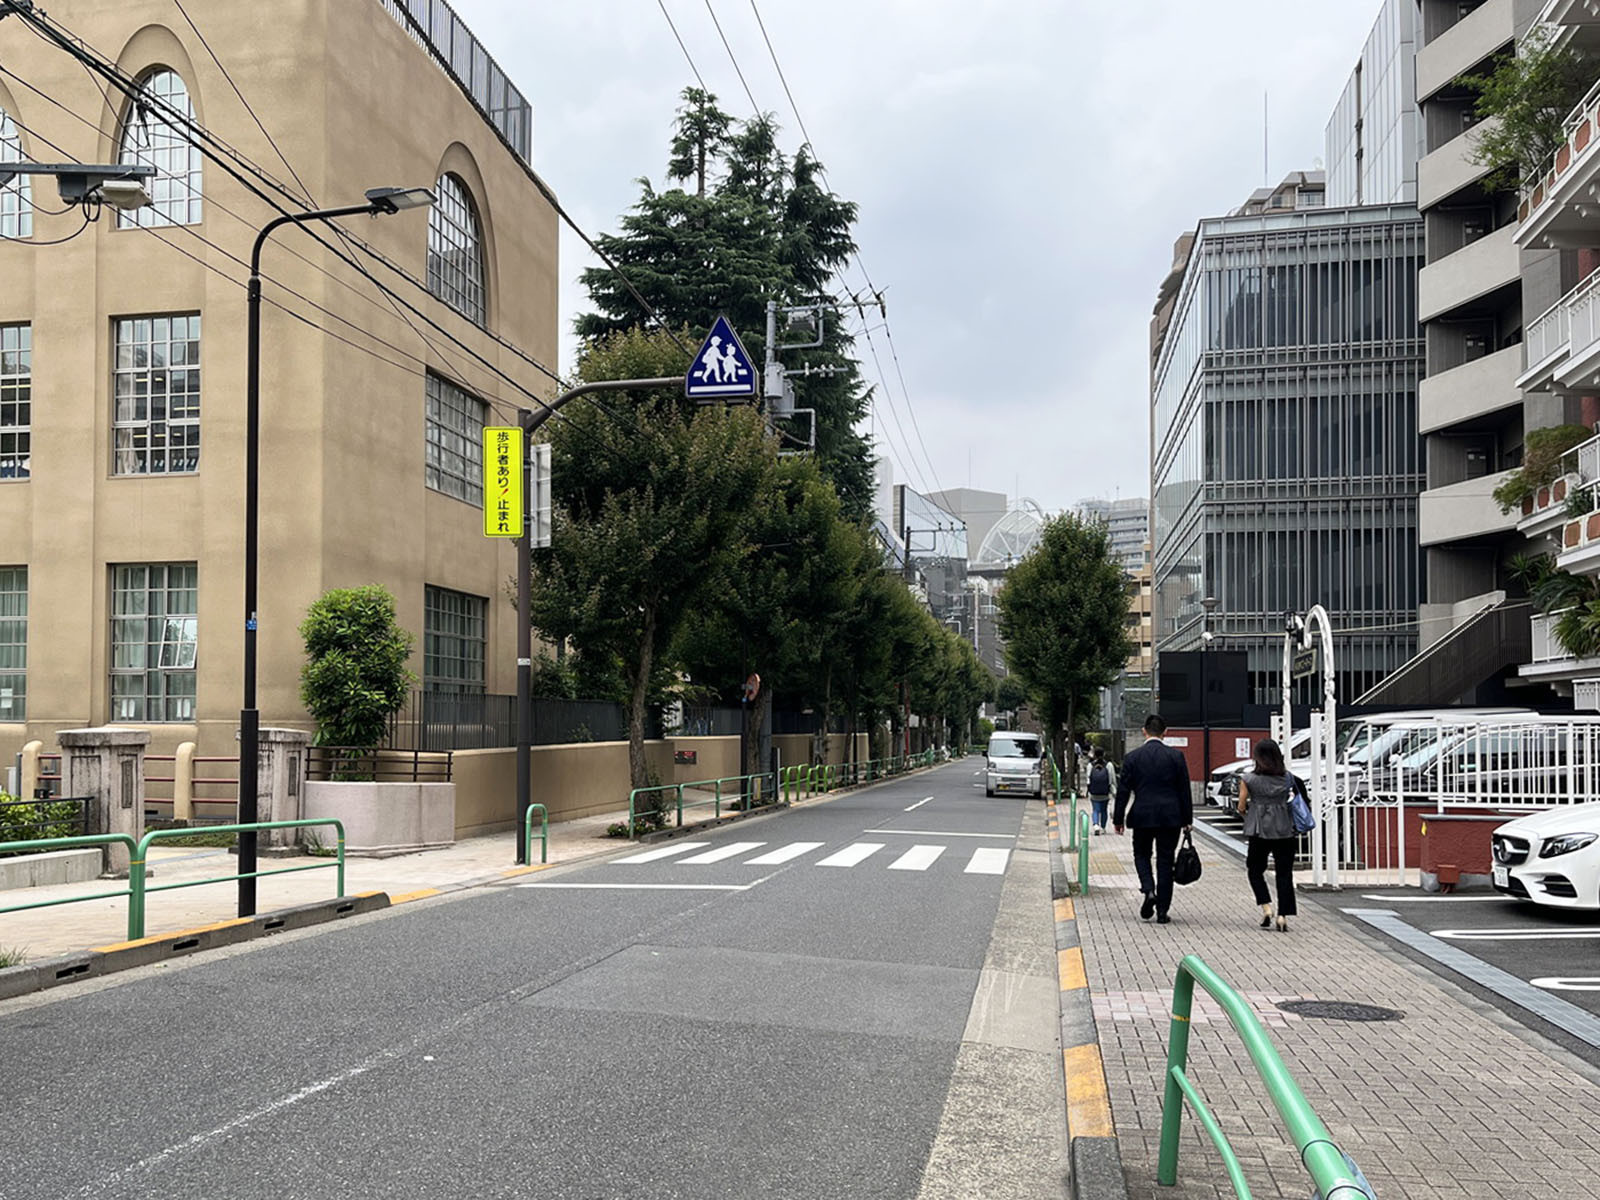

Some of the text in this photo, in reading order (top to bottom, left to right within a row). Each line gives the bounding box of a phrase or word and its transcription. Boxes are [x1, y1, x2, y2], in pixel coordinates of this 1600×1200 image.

[497, 431, 510, 532] 歩行者あり!止まれ
